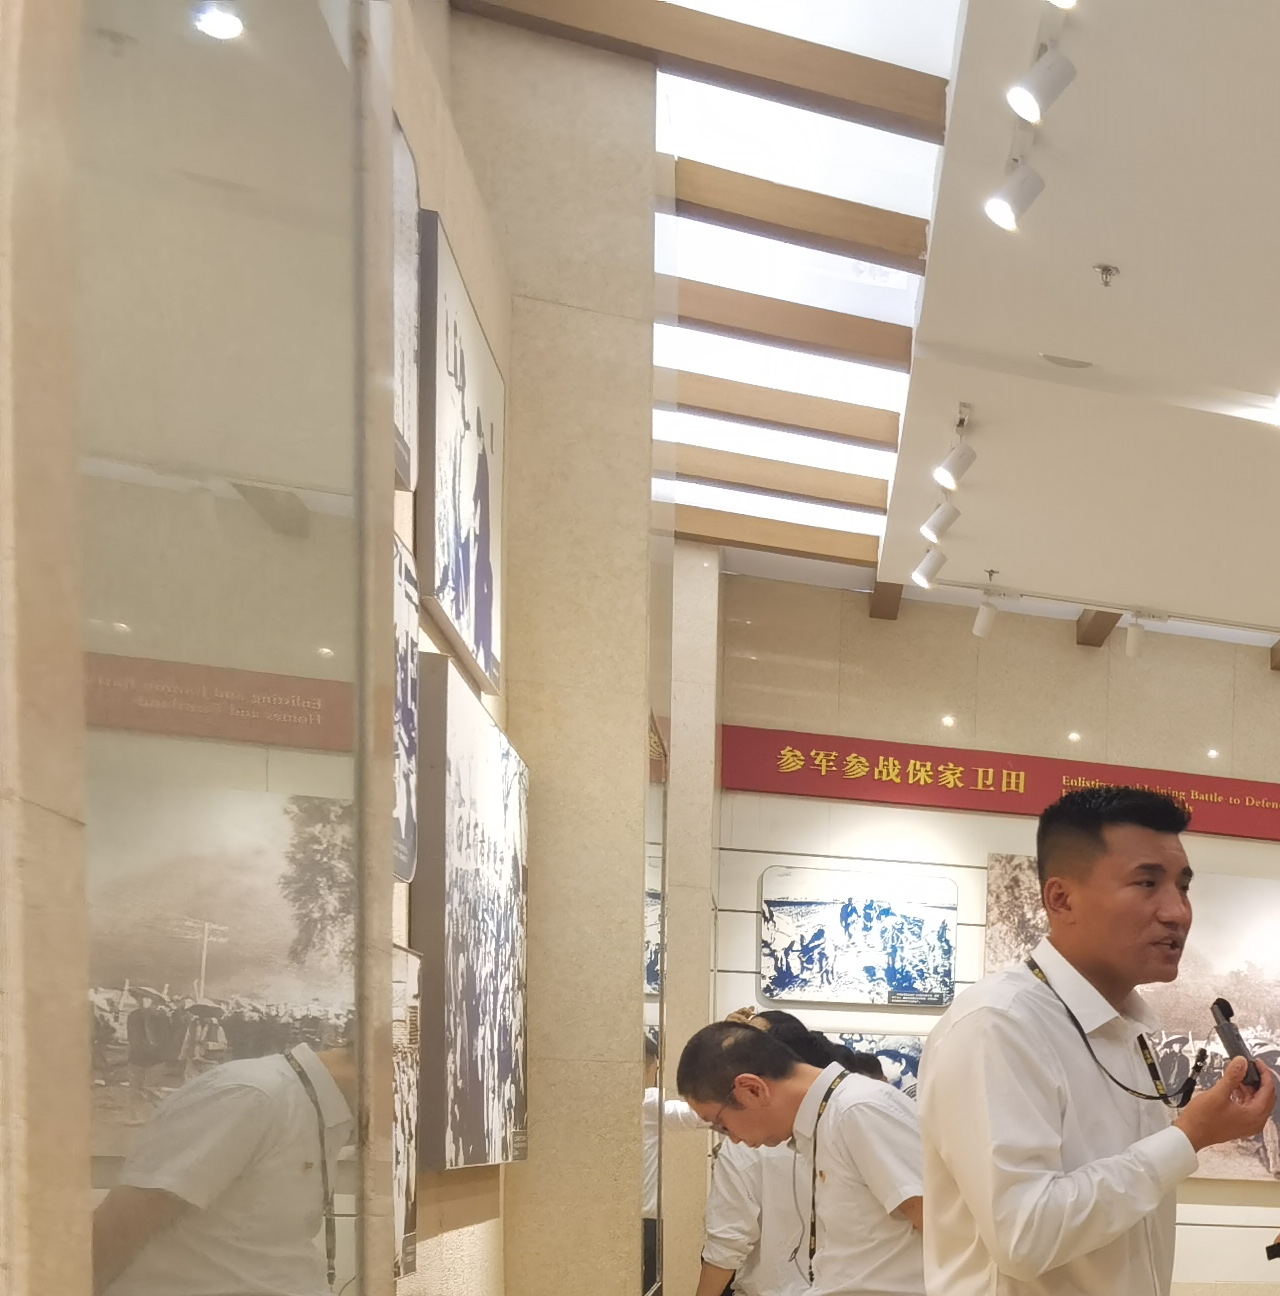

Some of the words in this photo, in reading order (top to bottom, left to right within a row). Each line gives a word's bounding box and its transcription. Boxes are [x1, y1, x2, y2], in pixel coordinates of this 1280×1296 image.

[776, 745, 1026, 794] 参军参战保家卫田
[1062, 775, 1114, 789] Enlistin
[1190, 788, 1224, 803] Battle
[1229, 795, 1240, 805] to
